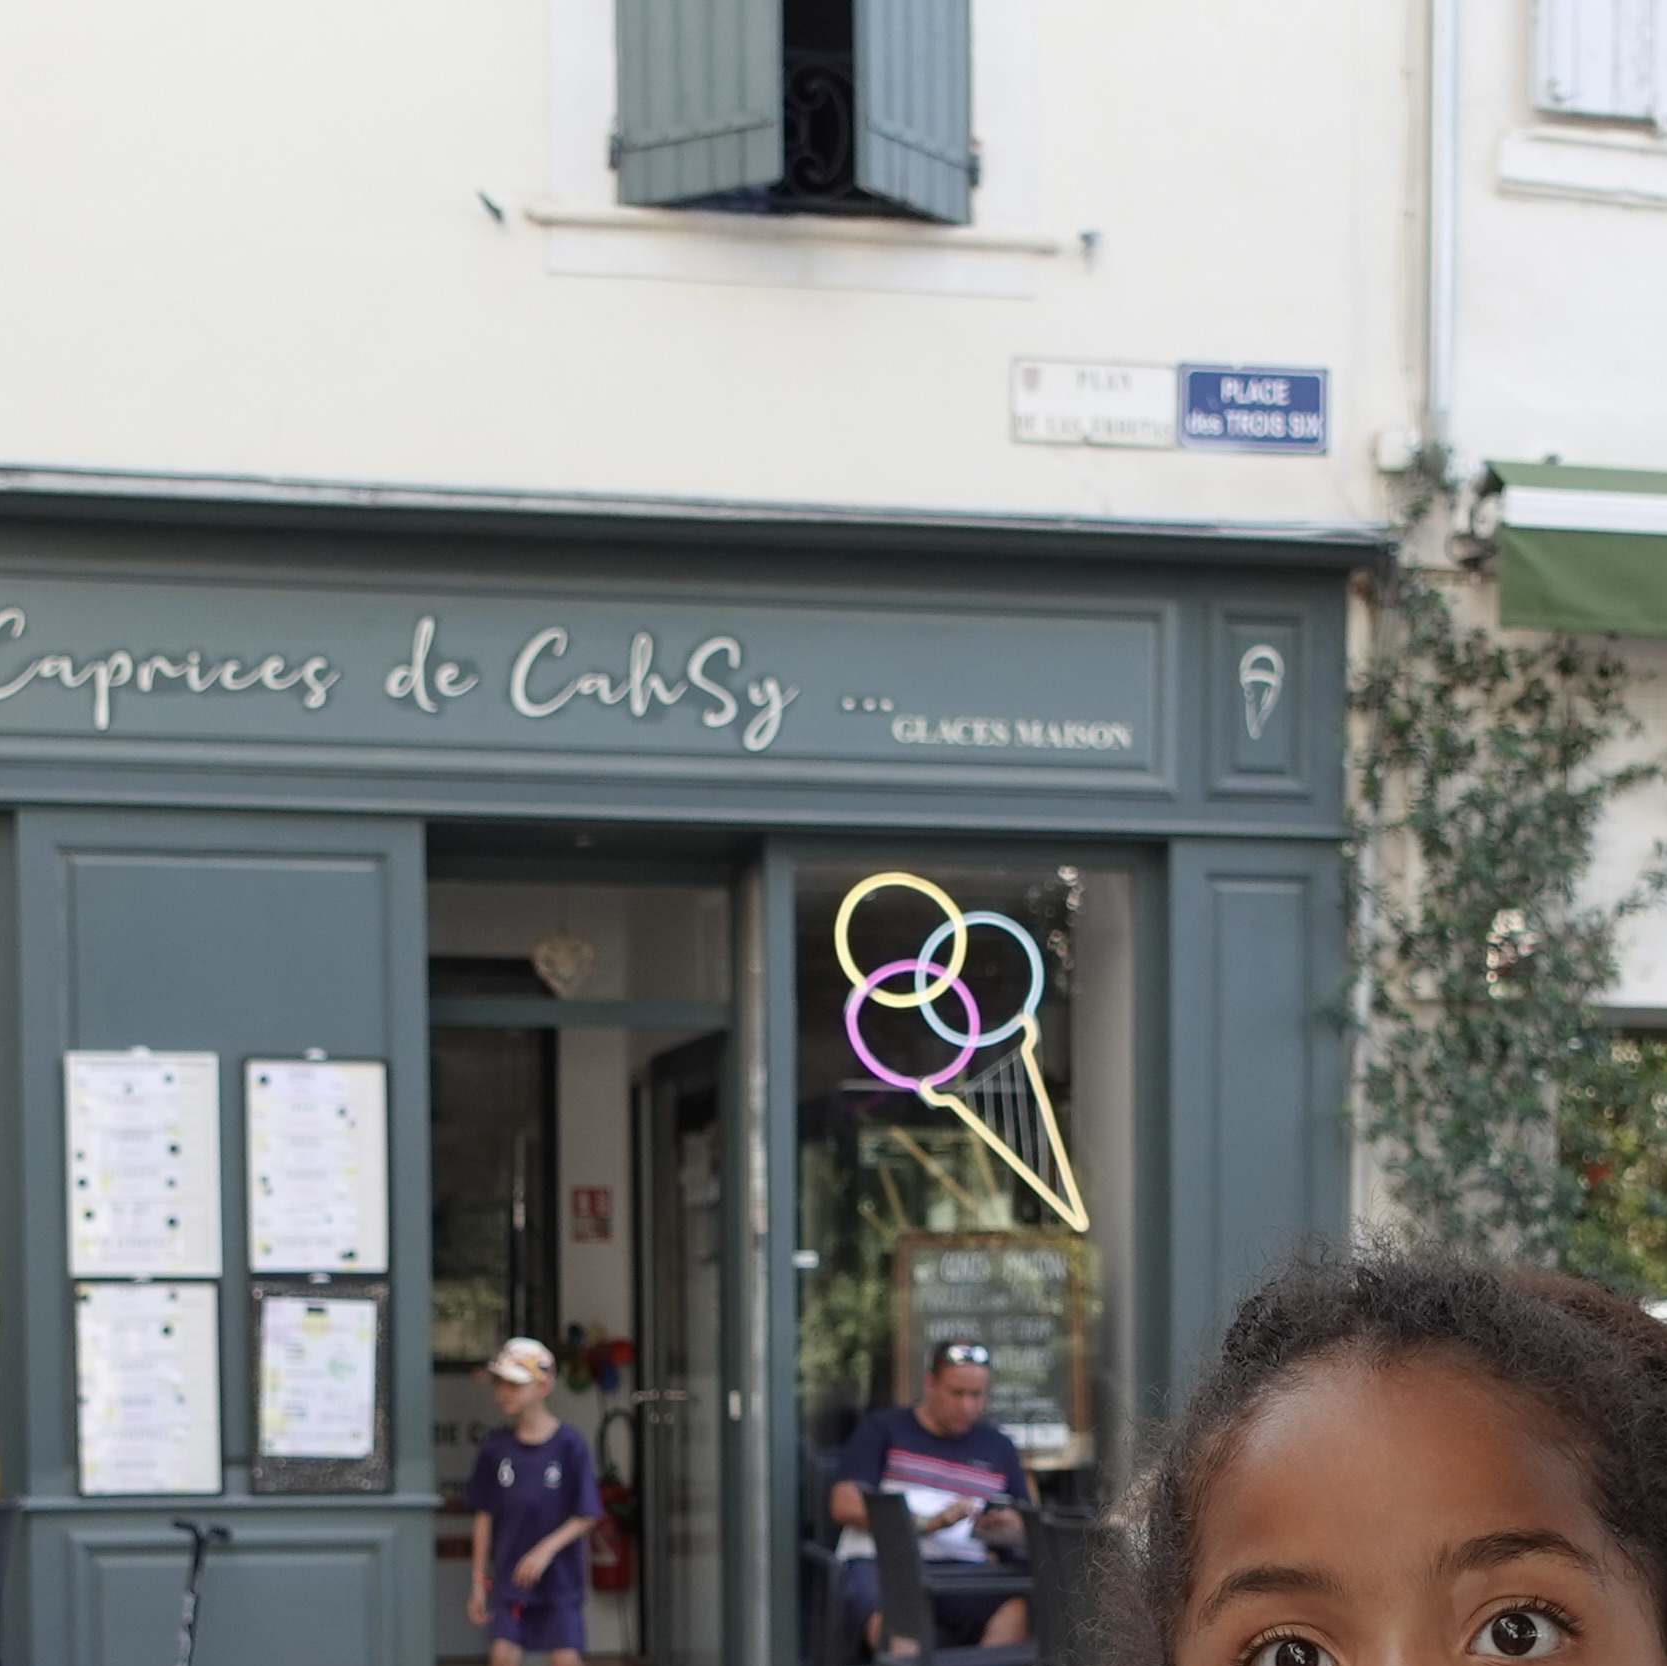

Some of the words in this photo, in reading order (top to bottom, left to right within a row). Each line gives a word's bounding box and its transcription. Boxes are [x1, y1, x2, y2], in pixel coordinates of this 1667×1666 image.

[1221, 378, 1291, 407] PLACE
[1186, 408, 1223, 437] des
[1226, 410, 1285, 439] TROIS
[1288, 412, 1324, 441] SIX
[384, 614, 479, 714] de
[509, 625, 799, 753] CahSy
[892, 715, 1007, 749] GLACES
[1014, 718, 1133, 753] MAISON
